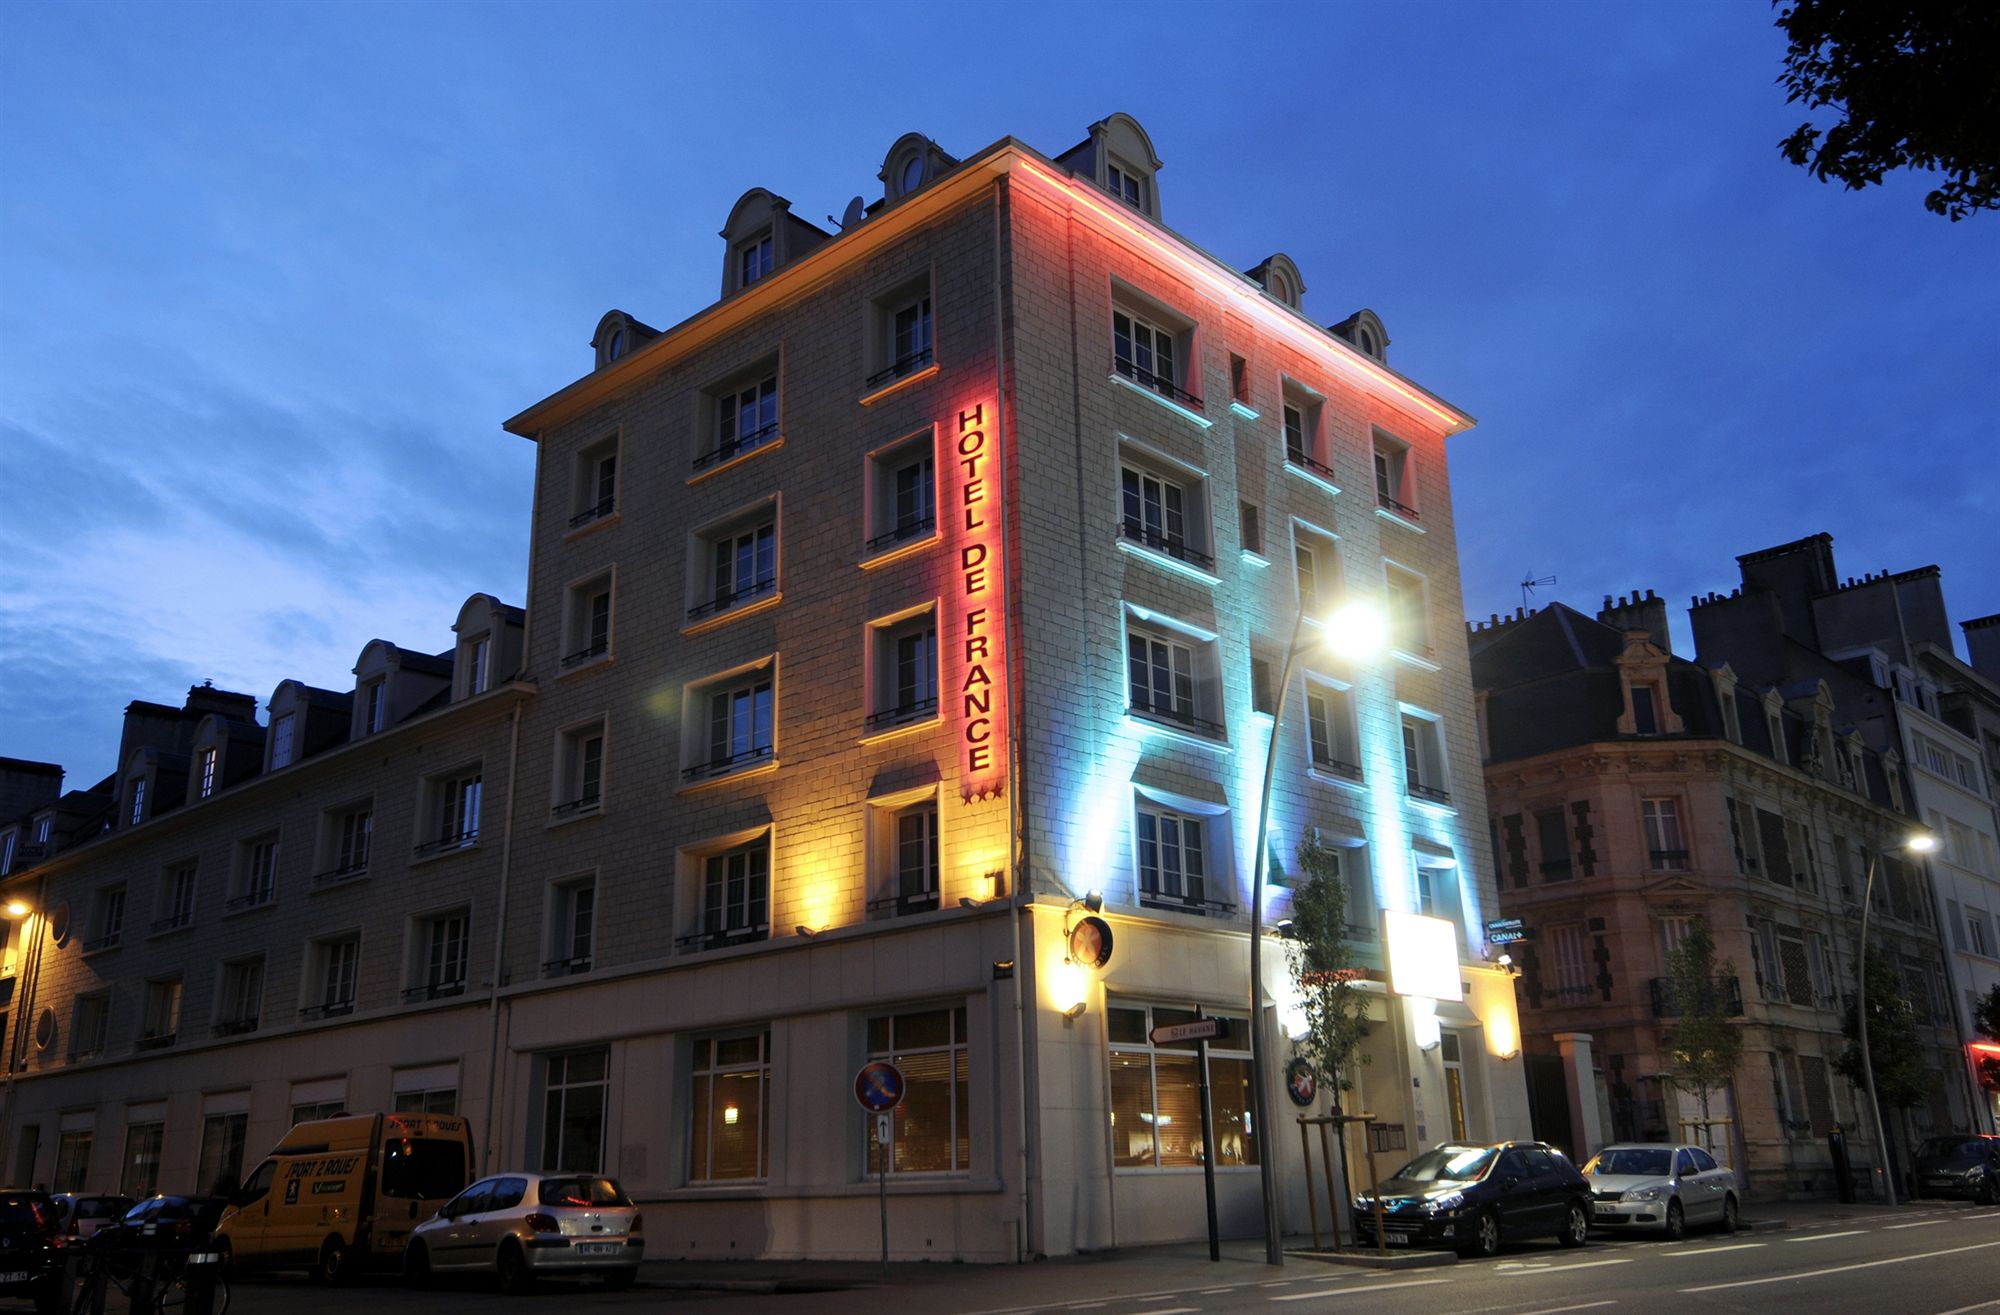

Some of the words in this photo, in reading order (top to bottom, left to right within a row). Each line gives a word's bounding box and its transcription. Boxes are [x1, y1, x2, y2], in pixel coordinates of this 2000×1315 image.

[958, 403, 985, 532] HOTEL
[961, 543, 987, 596] DE
[962, 608, 991, 773] FRANCE
[1491, 931, 1523, 942] CANAL+
[284, 1161, 317, 1179] SPORT
[316, 1160, 326, 1177] 2
[325, 1157, 359, 1176] ROUES
